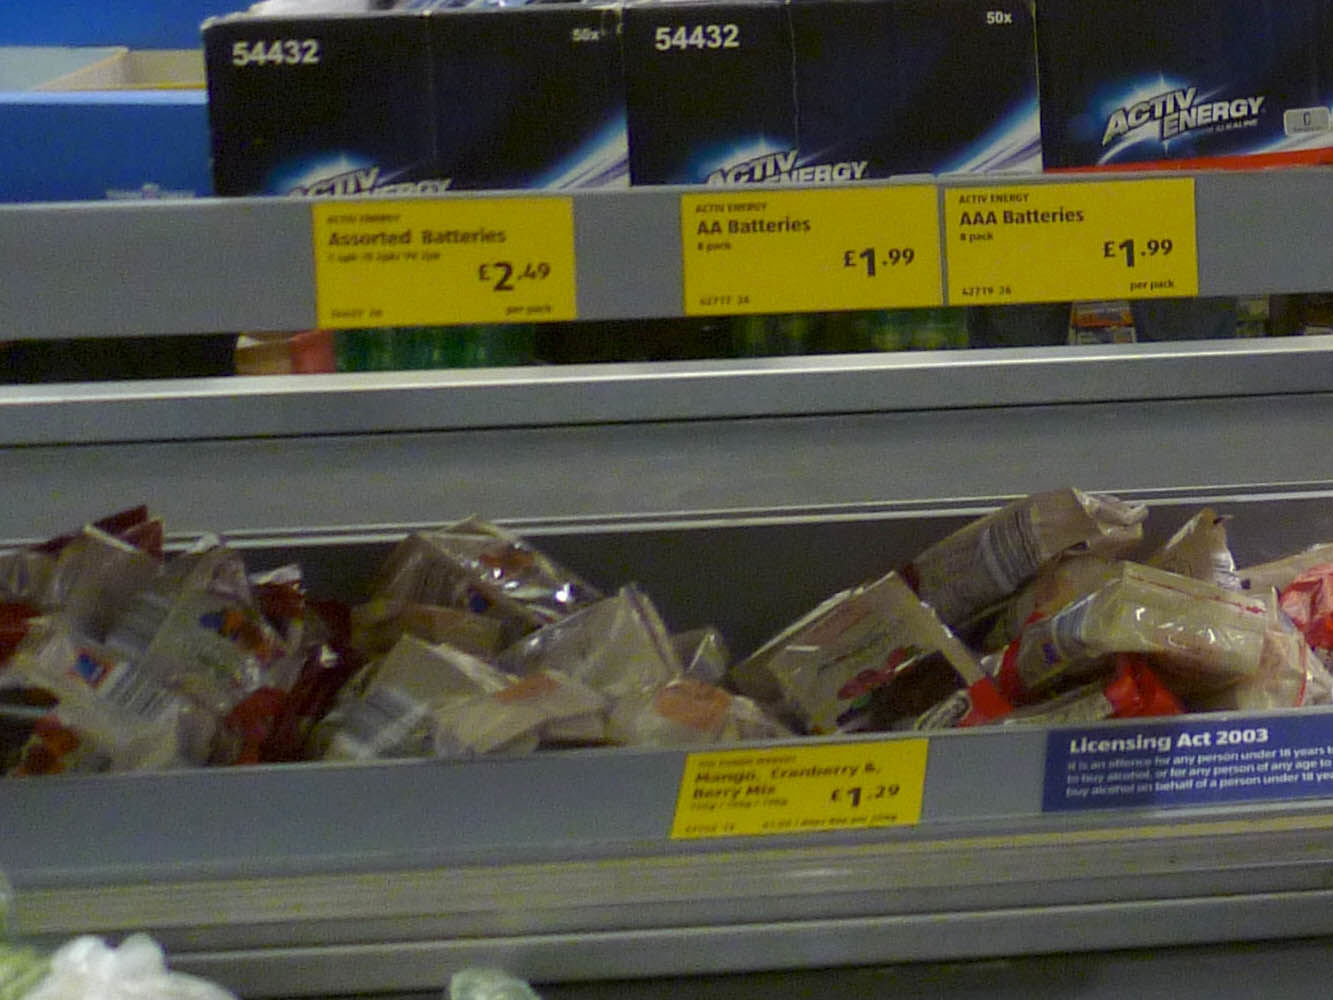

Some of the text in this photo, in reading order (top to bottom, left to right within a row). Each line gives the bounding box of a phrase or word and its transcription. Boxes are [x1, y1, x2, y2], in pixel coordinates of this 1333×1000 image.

[986, 10, 1013, 25] 50x
[654, 24, 740, 51] 54432
[232, 38, 320, 67] 54432
[1101, 87, 1199, 146] ACTIV
[1160, 96, 1266, 141] ENERGY
[1302, 109, 1312, 126] C
[959, 193, 1029, 204] ACTIV ENERGY
[697, 216, 812, 235] AA Batteries
[960, 207, 1084, 226] AAA Batteries
[328, 228, 507, 246] Assorted Batteries
[969, 231, 994, 242] pack
[843, 248, 916, 277] £1.99
[1103, 239, 1173, 268] £1.99
[478, 260, 551, 292] £2.49
[1130, 278, 1175, 292] per pack
[1070, 727, 1269, 754] Licensing Act 2003
[1173, 755, 1195, 767] any
[1197, 752, 1239, 766] person
[1241, 750, 1277, 760] under
[1279, 747, 1291, 758] 18
[1293, 747, 1325, 759] years
[771, 764, 858, 781] Cranberry
[1170, 767, 1186, 778] for
[1189, 767, 1211, 779] any
[1213, 763, 1255, 777] person
[1256, 762, 1269, 773] of
[1271, 762, 1292, 774] any
[1295, 760, 1318, 772] age
[1320, 757, 1332, 768] to
[1155, 779, 1193, 792] behalf
[1195, 778, 1208, 789] of
[1209, 779, 1217, 788] a
[1219, 776, 1260, 790] person
[1263, 773, 1299, 785] under
[1302, 771, 1314, 782] 18
[693, 784, 901, 808] Berry Mix £1.29
